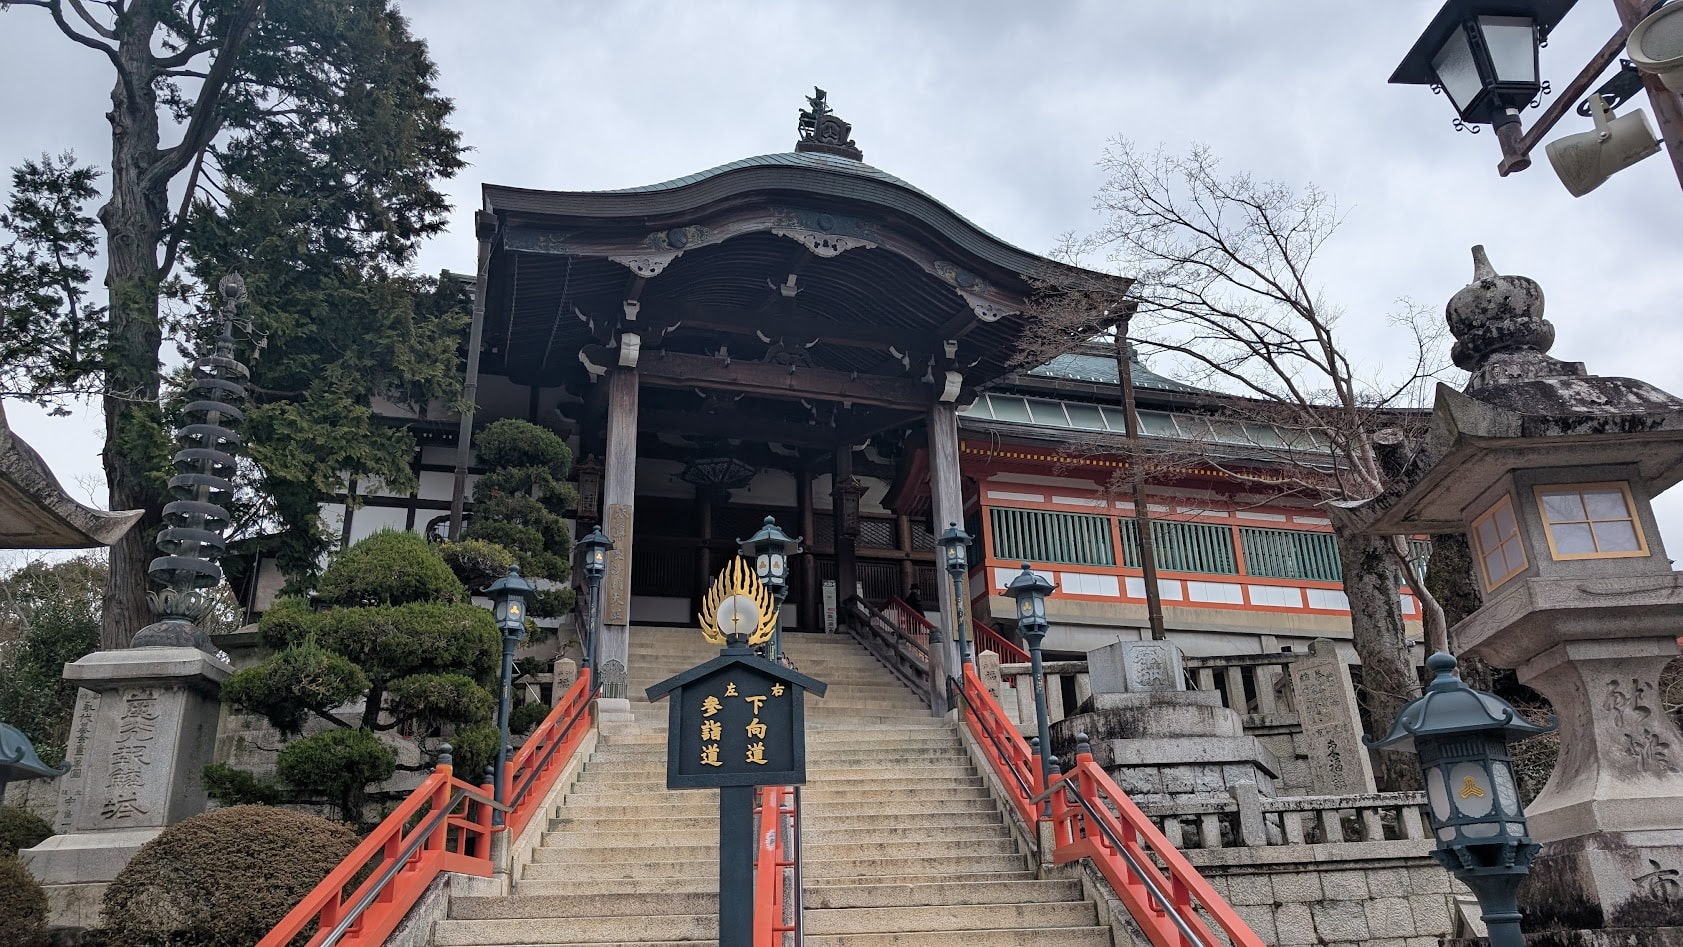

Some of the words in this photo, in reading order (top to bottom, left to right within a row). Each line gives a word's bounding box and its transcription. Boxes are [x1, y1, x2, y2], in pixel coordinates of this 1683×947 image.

[724, 682, 739, 697] 左
[771, 682, 785, 697] 右
[700, 696, 723, 767] 参詣道
[745, 695, 768, 765] 下向道
